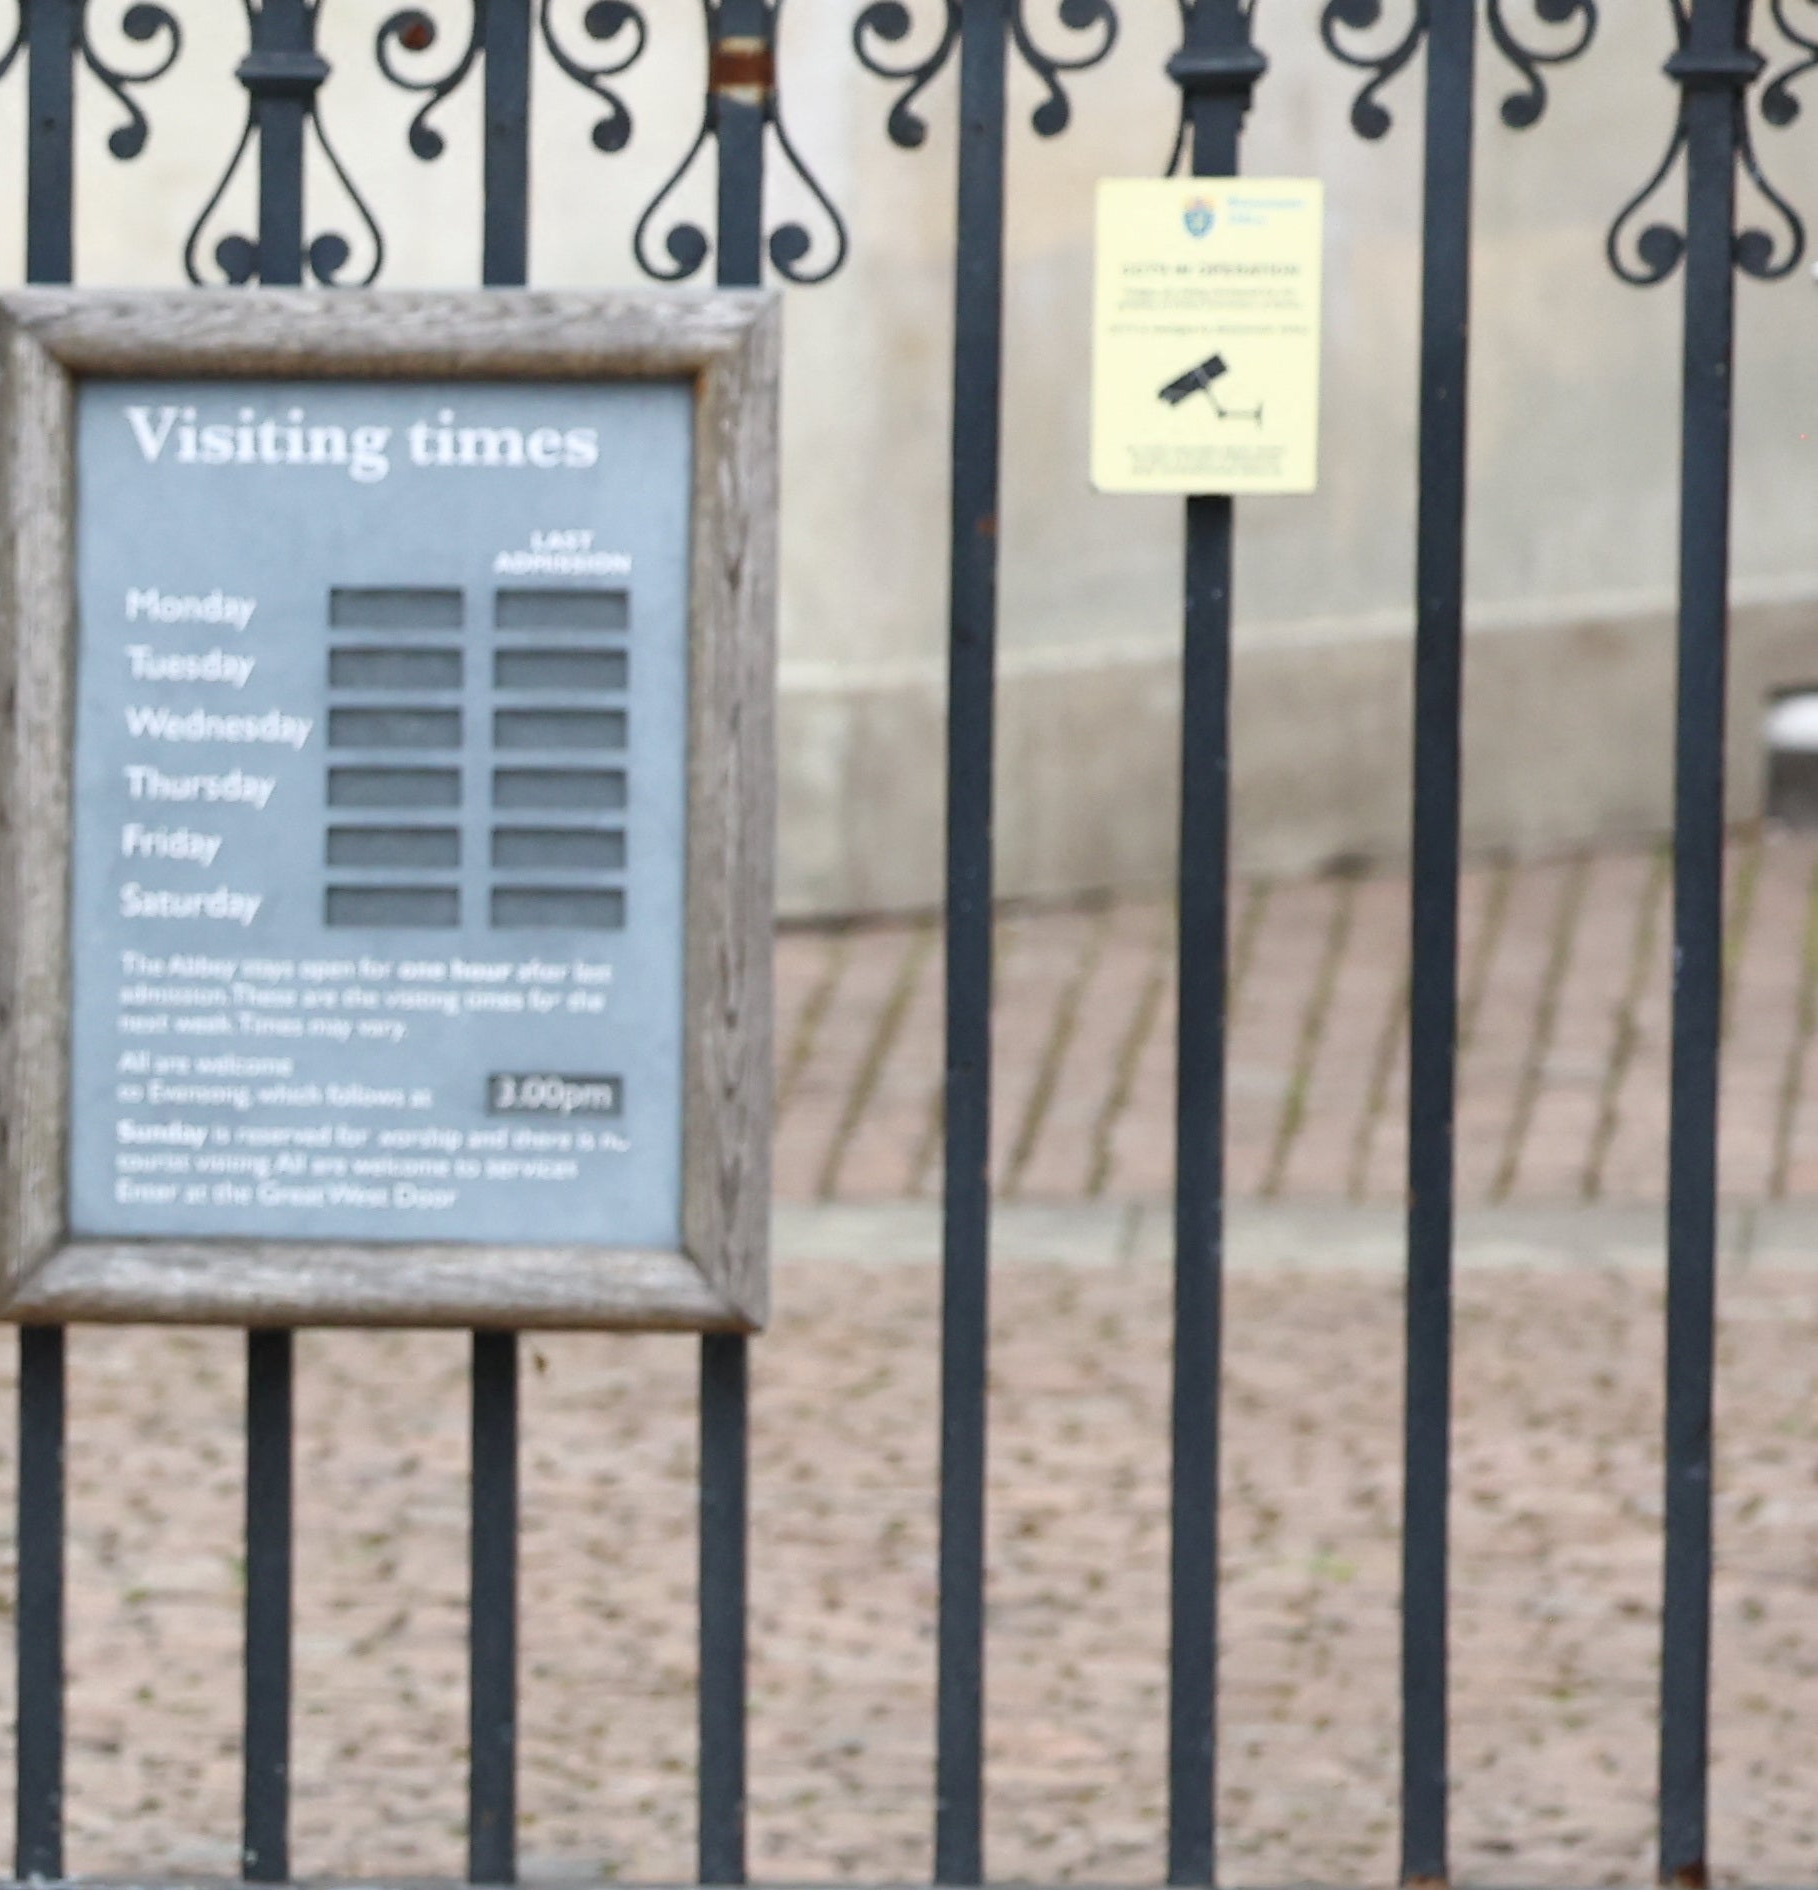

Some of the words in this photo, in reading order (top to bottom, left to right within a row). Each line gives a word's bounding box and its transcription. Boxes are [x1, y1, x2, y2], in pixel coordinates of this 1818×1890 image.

[125, 405, 392, 484] Visiting
[407, 407, 600, 469] times
[529, 529, 595, 552] LAST
[493, 551, 632, 575] ADMISSION
[124, 586, 258, 632] Monday
[124, 643, 257, 690] Tuesday
[123, 705, 314, 751] Wednesday
[122, 764, 277, 811] Thursday
[121, 822, 222, 868] Friday
[119, 880, 263, 928] Saturday
[123, 950, 164, 977] The
[168, 954, 238, 982] Abbey
[297, 959, 356, 984] open
[357, 956, 392, 981] for
[397, 961, 446, 982] one
[449, 956, 512, 983] hour
[301, 988, 339, 1009] are
[341, 985, 380, 1010] the
[382, 988, 460, 1016] visiting
[527, 986, 564, 1013] for
[567, 989, 608, 1014] the
[236, 1011, 303, 1037] Times
[306, 1018, 352, 1042] may
[117, 1049, 151, 1075] All
[153, 1056, 191, 1076] are
[194, 1053, 294, 1078] welcome
[258, 1083, 323, 1107] which
[324, 1083, 405, 1109] follows
[495, 1073, 614, 1115] 3.00pm
[116, 1118, 209, 1149] Sunday
[233, 1124, 332, 1147] reserved
[334, 1122, 371, 1148] for
[376, 1126, 464, 1152] worship
[465, 1126, 509, 1150] and
[511, 1126, 573, 1151] there
[274, 1151, 308, 1175] All
[309, 1156, 348, 1177] are
[351, 1155, 451, 1178] welcome
[453, 1157, 482, 1179] to
[115, 1176, 180, 1203] Enter
[210, 1180, 255, 1205] the
[256, 1178, 325, 1206] Great
[326, 1180, 389, 1208] West
[391, 1181, 460, 1209] Door
